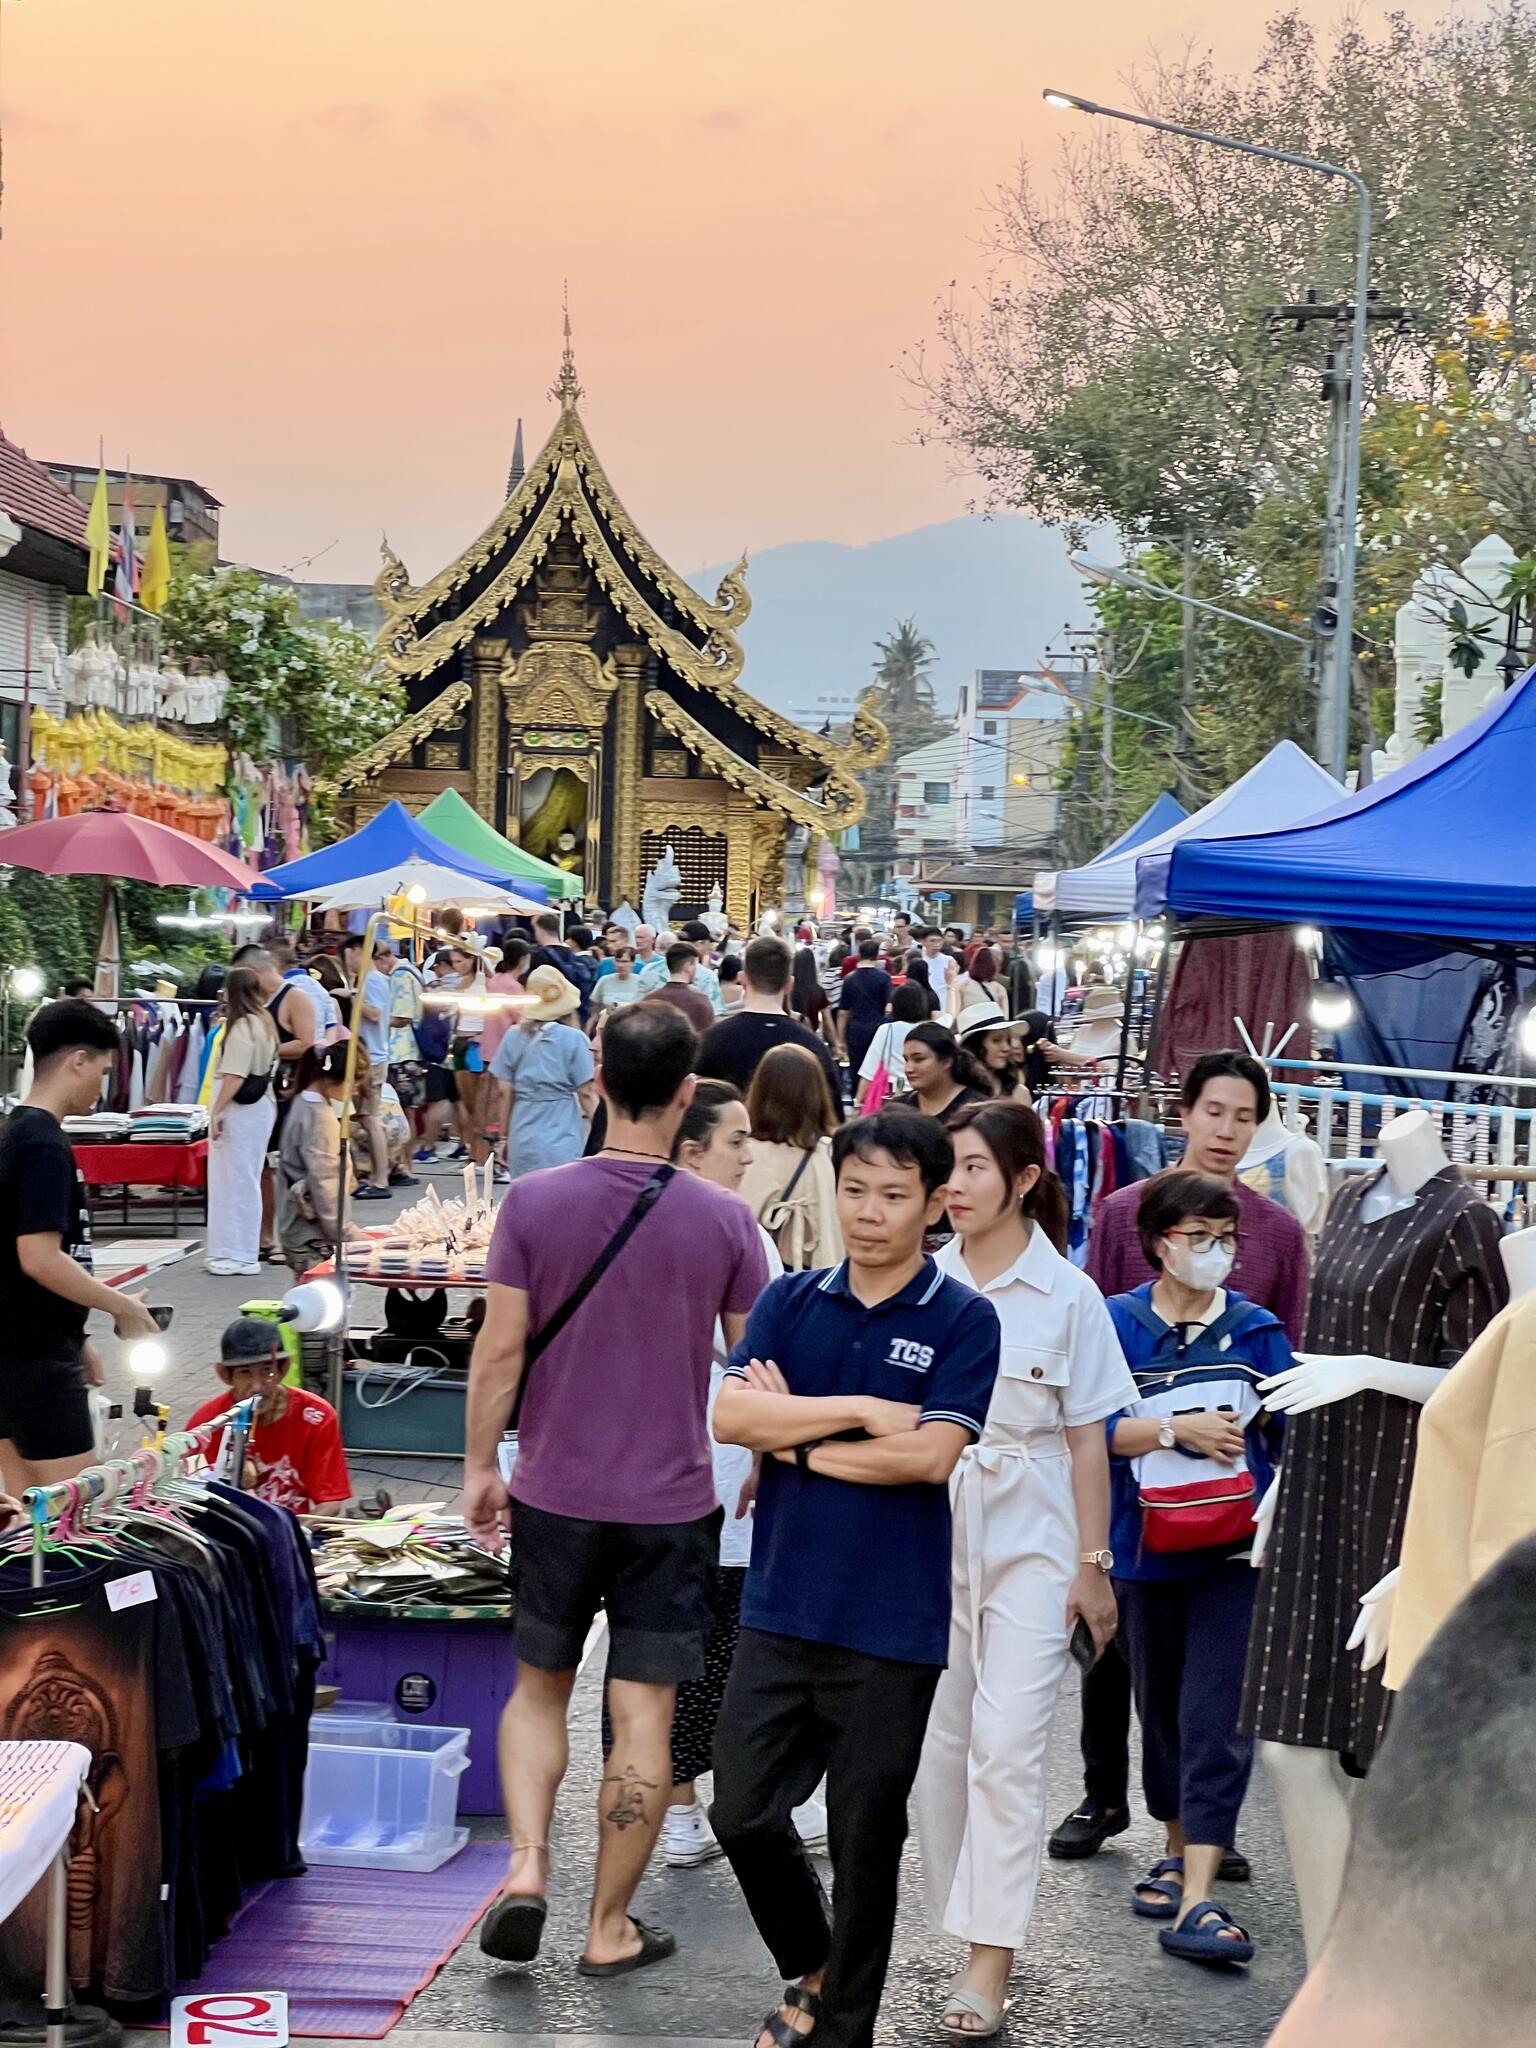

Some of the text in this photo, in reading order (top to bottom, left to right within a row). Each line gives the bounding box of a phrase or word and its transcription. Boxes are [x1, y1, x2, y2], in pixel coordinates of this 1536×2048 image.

[890, 1338, 935, 1368] TCS
[113, 1579, 142, 1603] 70
[184, 1996, 278, 2045] 70
